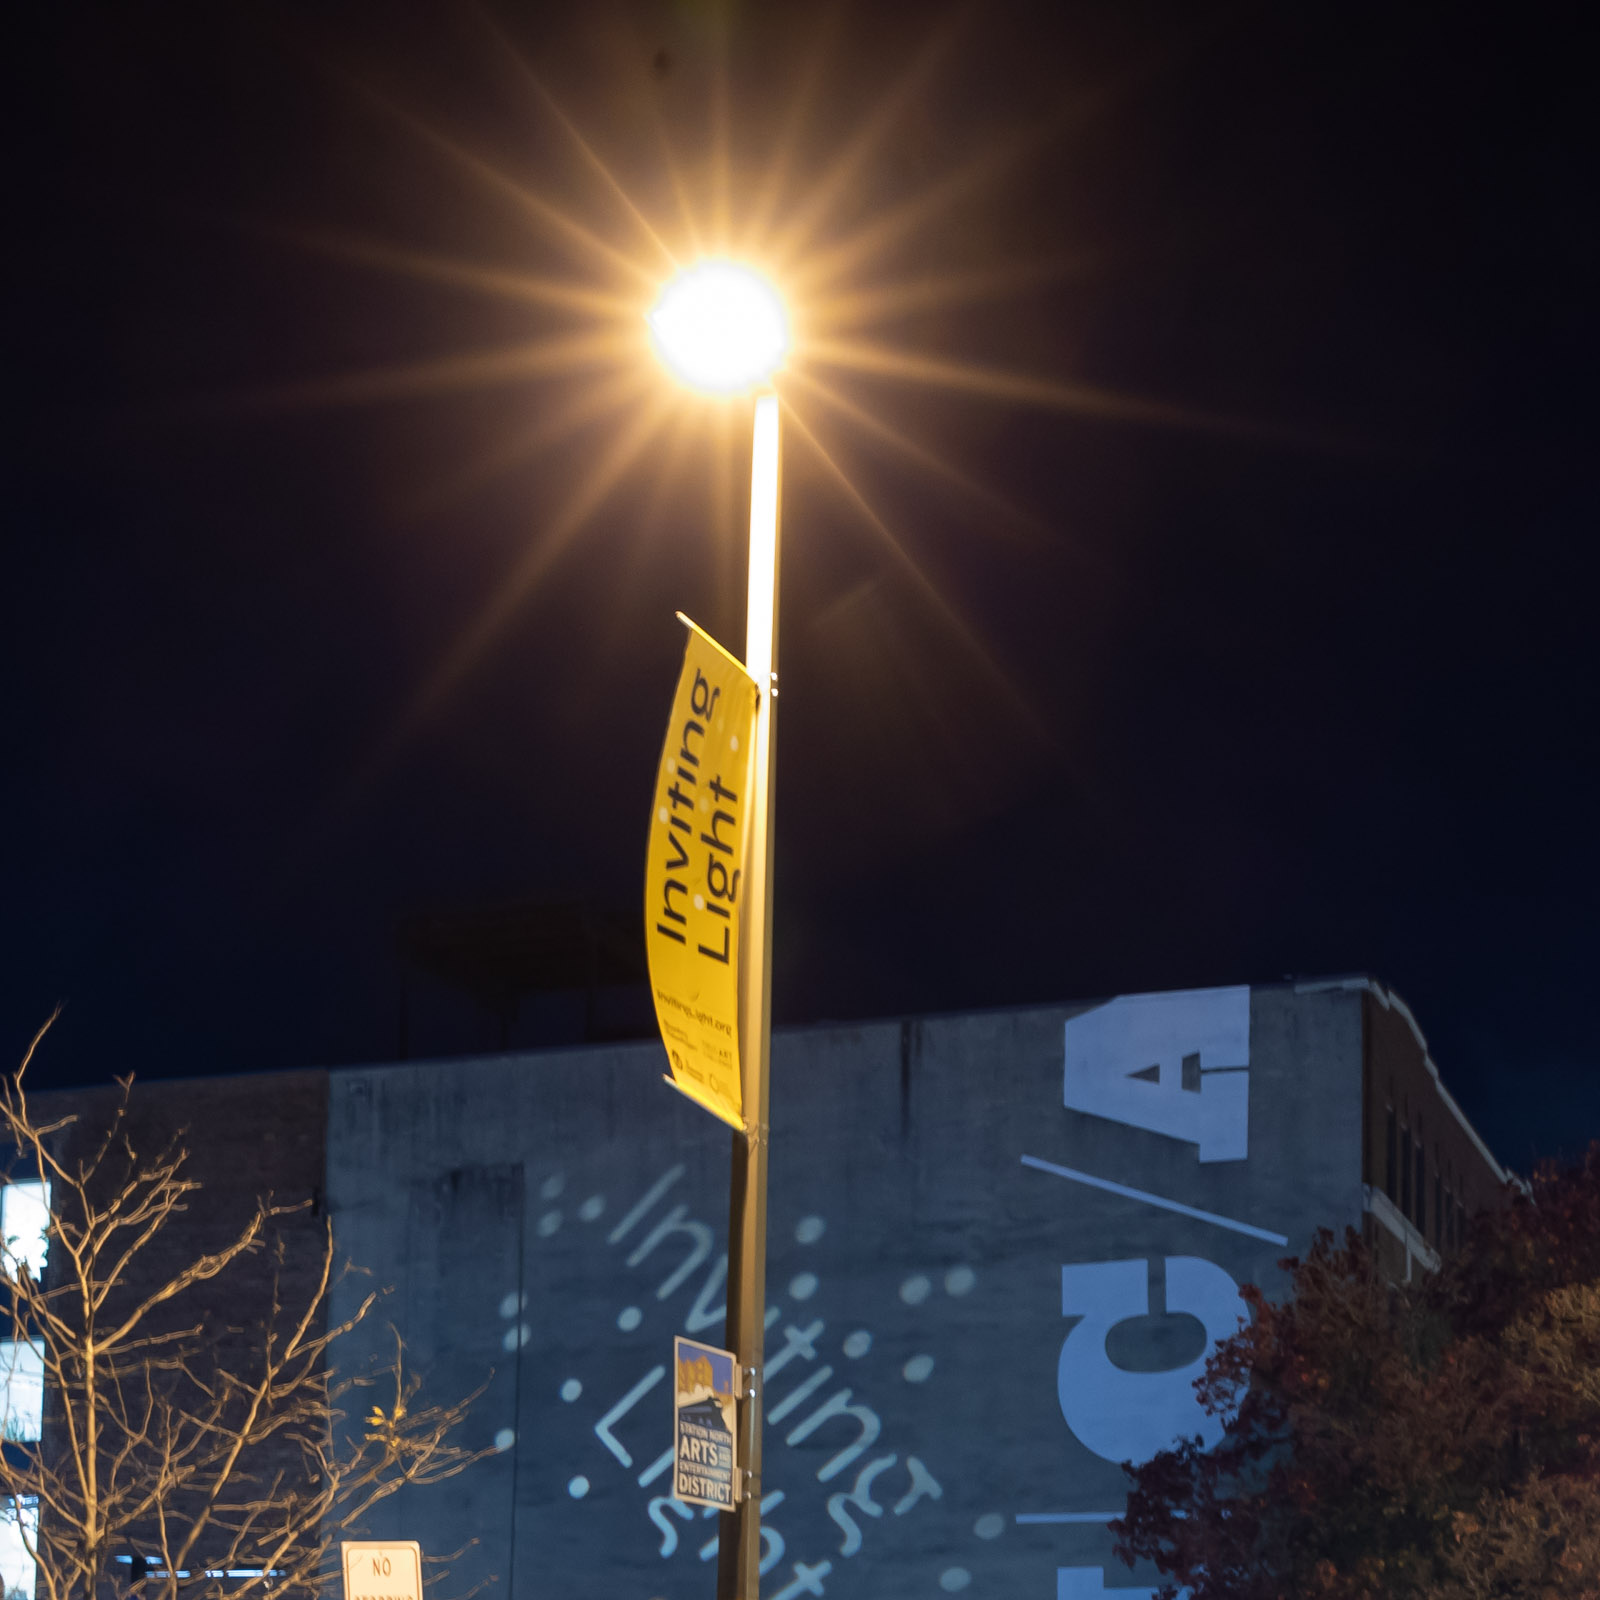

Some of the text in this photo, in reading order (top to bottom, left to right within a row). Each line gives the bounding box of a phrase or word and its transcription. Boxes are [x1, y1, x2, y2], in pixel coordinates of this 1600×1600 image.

[657, 668, 720, 945] Inviting
[698, 774, 740, 965] Light
[607, 1163, 943, 1557] Invting
[680, 1421, 731, 1446] STATION NORTH
[679, 1435, 718, 1467] ARTS
[679, 1474, 731, 1503] DISTRICT
[372, 1557, 391, 1577] NO
